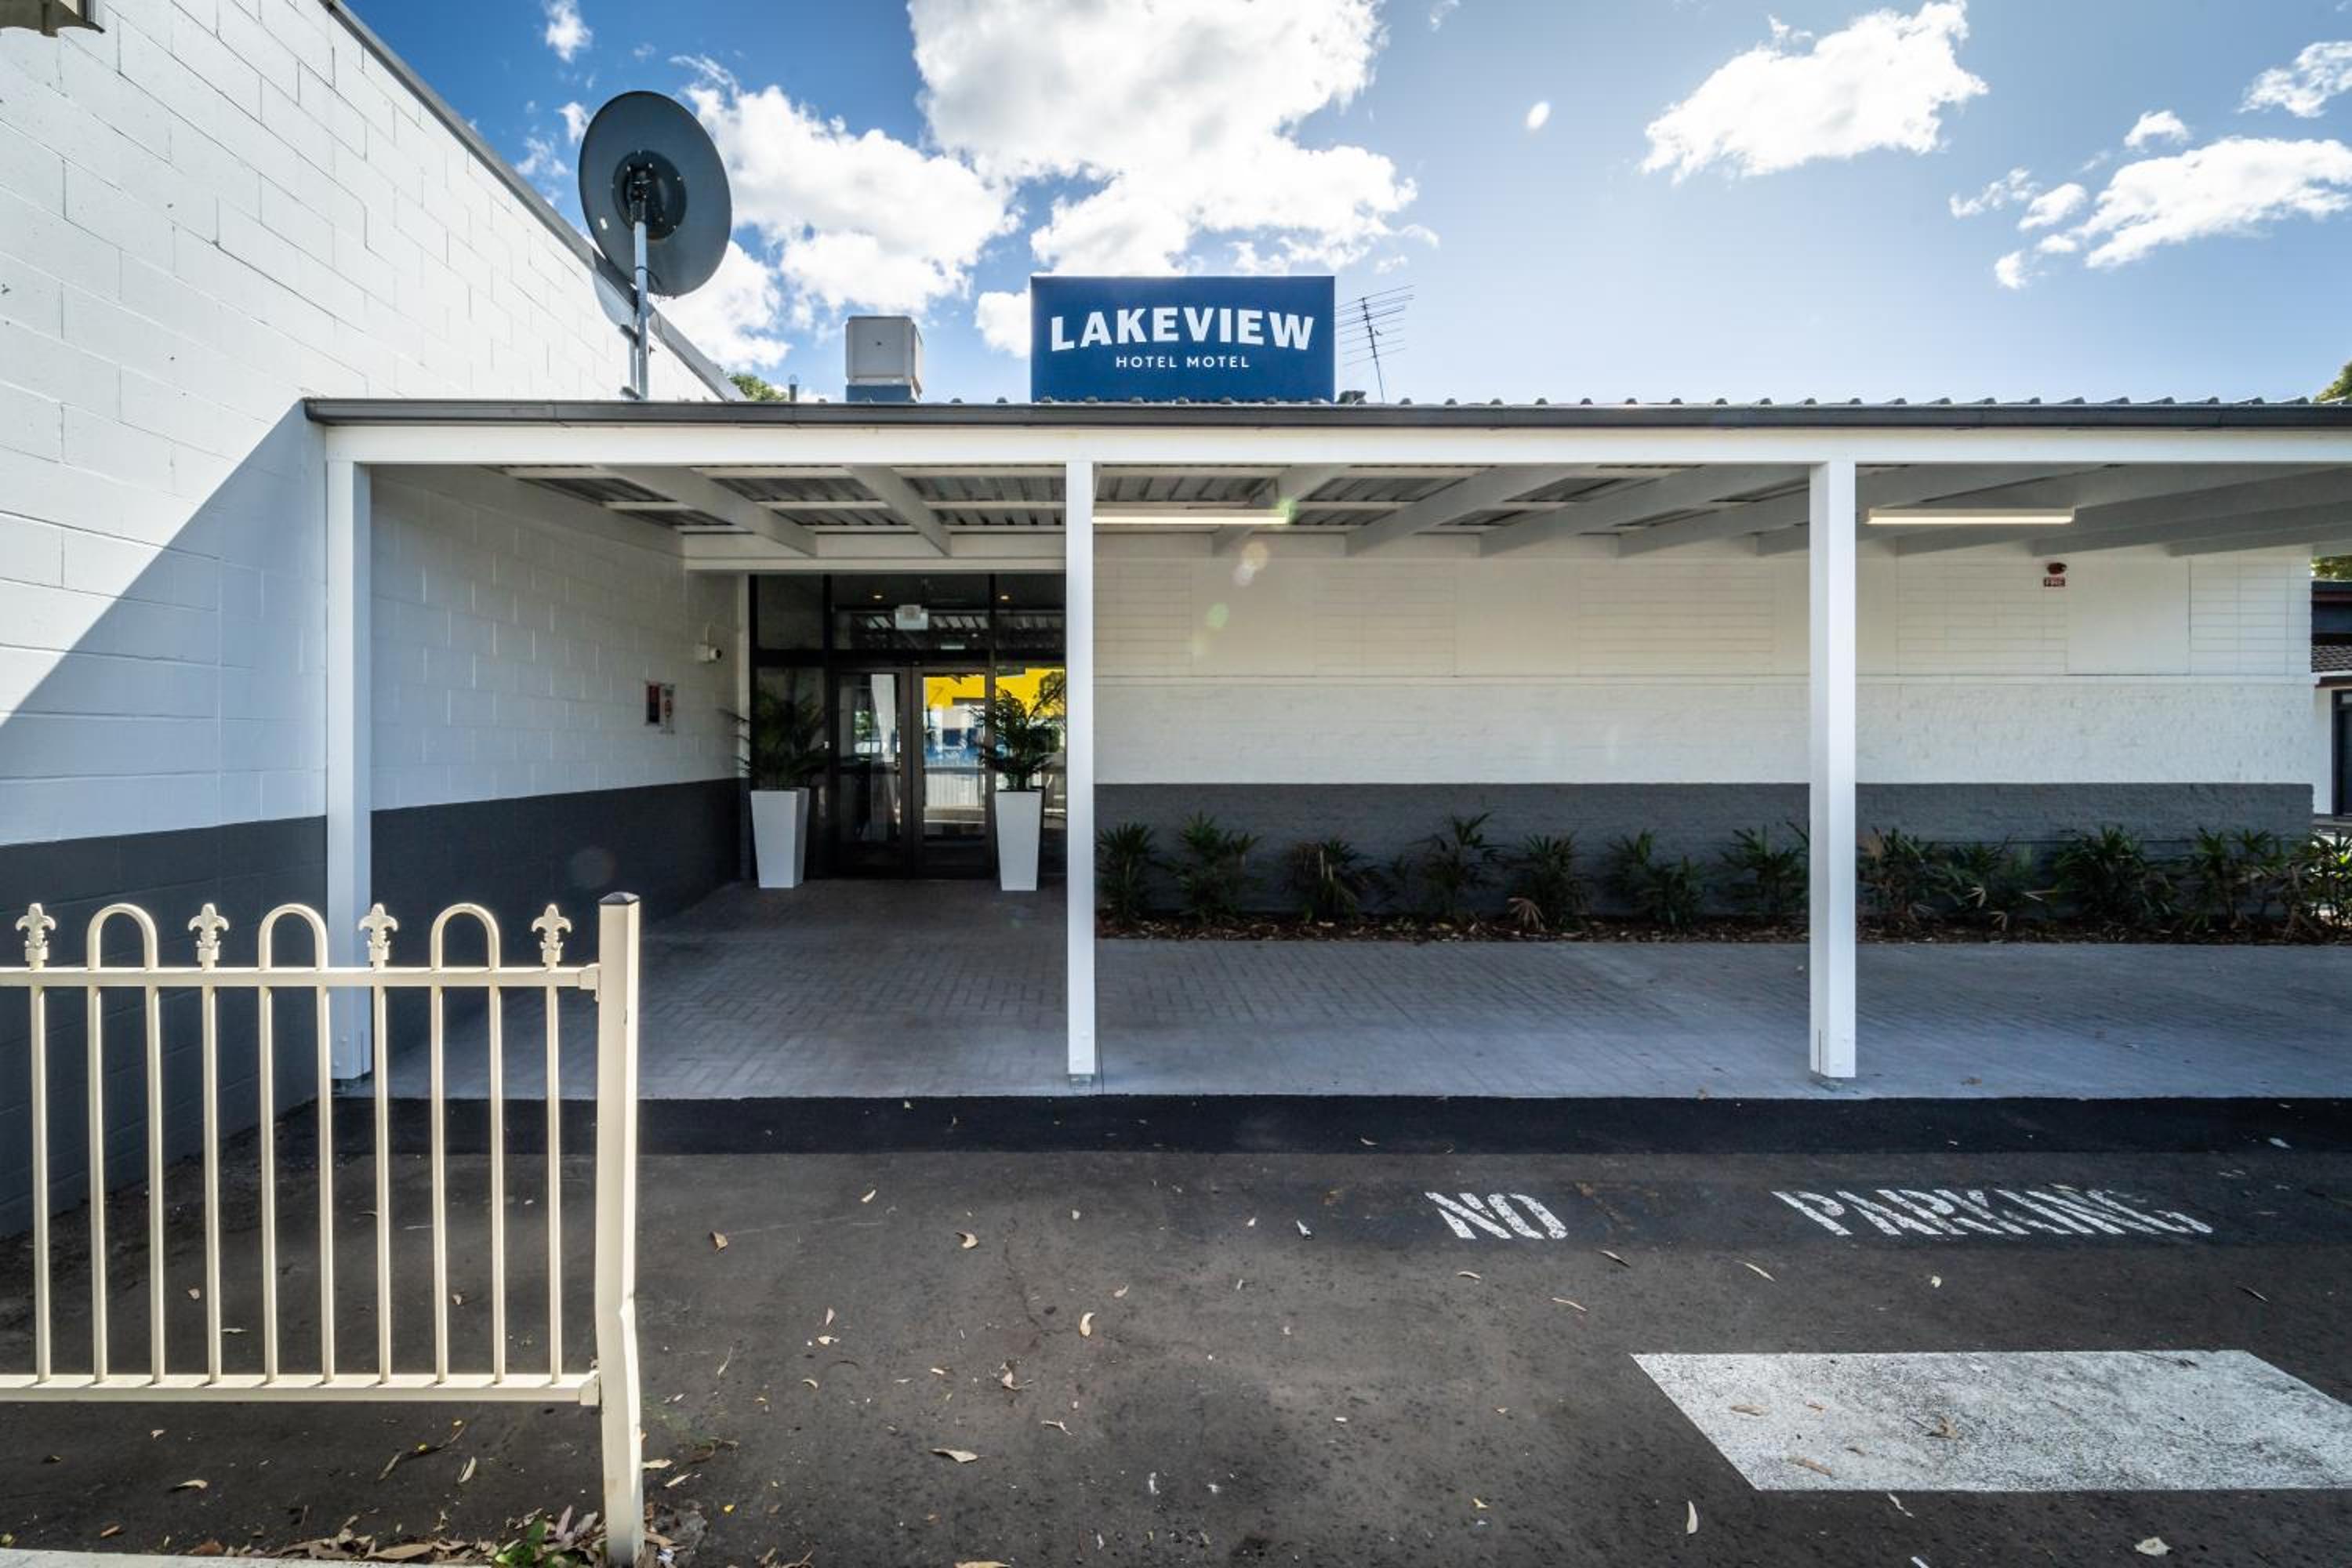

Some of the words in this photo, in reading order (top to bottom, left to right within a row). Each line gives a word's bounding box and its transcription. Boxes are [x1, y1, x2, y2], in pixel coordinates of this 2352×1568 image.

[1051, 307, 1314, 352] LAKEVIEW
[1116, 355, 1178, 368] HOTEL
[1185, 355, 1250, 368] MOTEL
[1424, 1191, 1569, 1240] NO
[1770, 1189, 2214, 1236] PARKING
